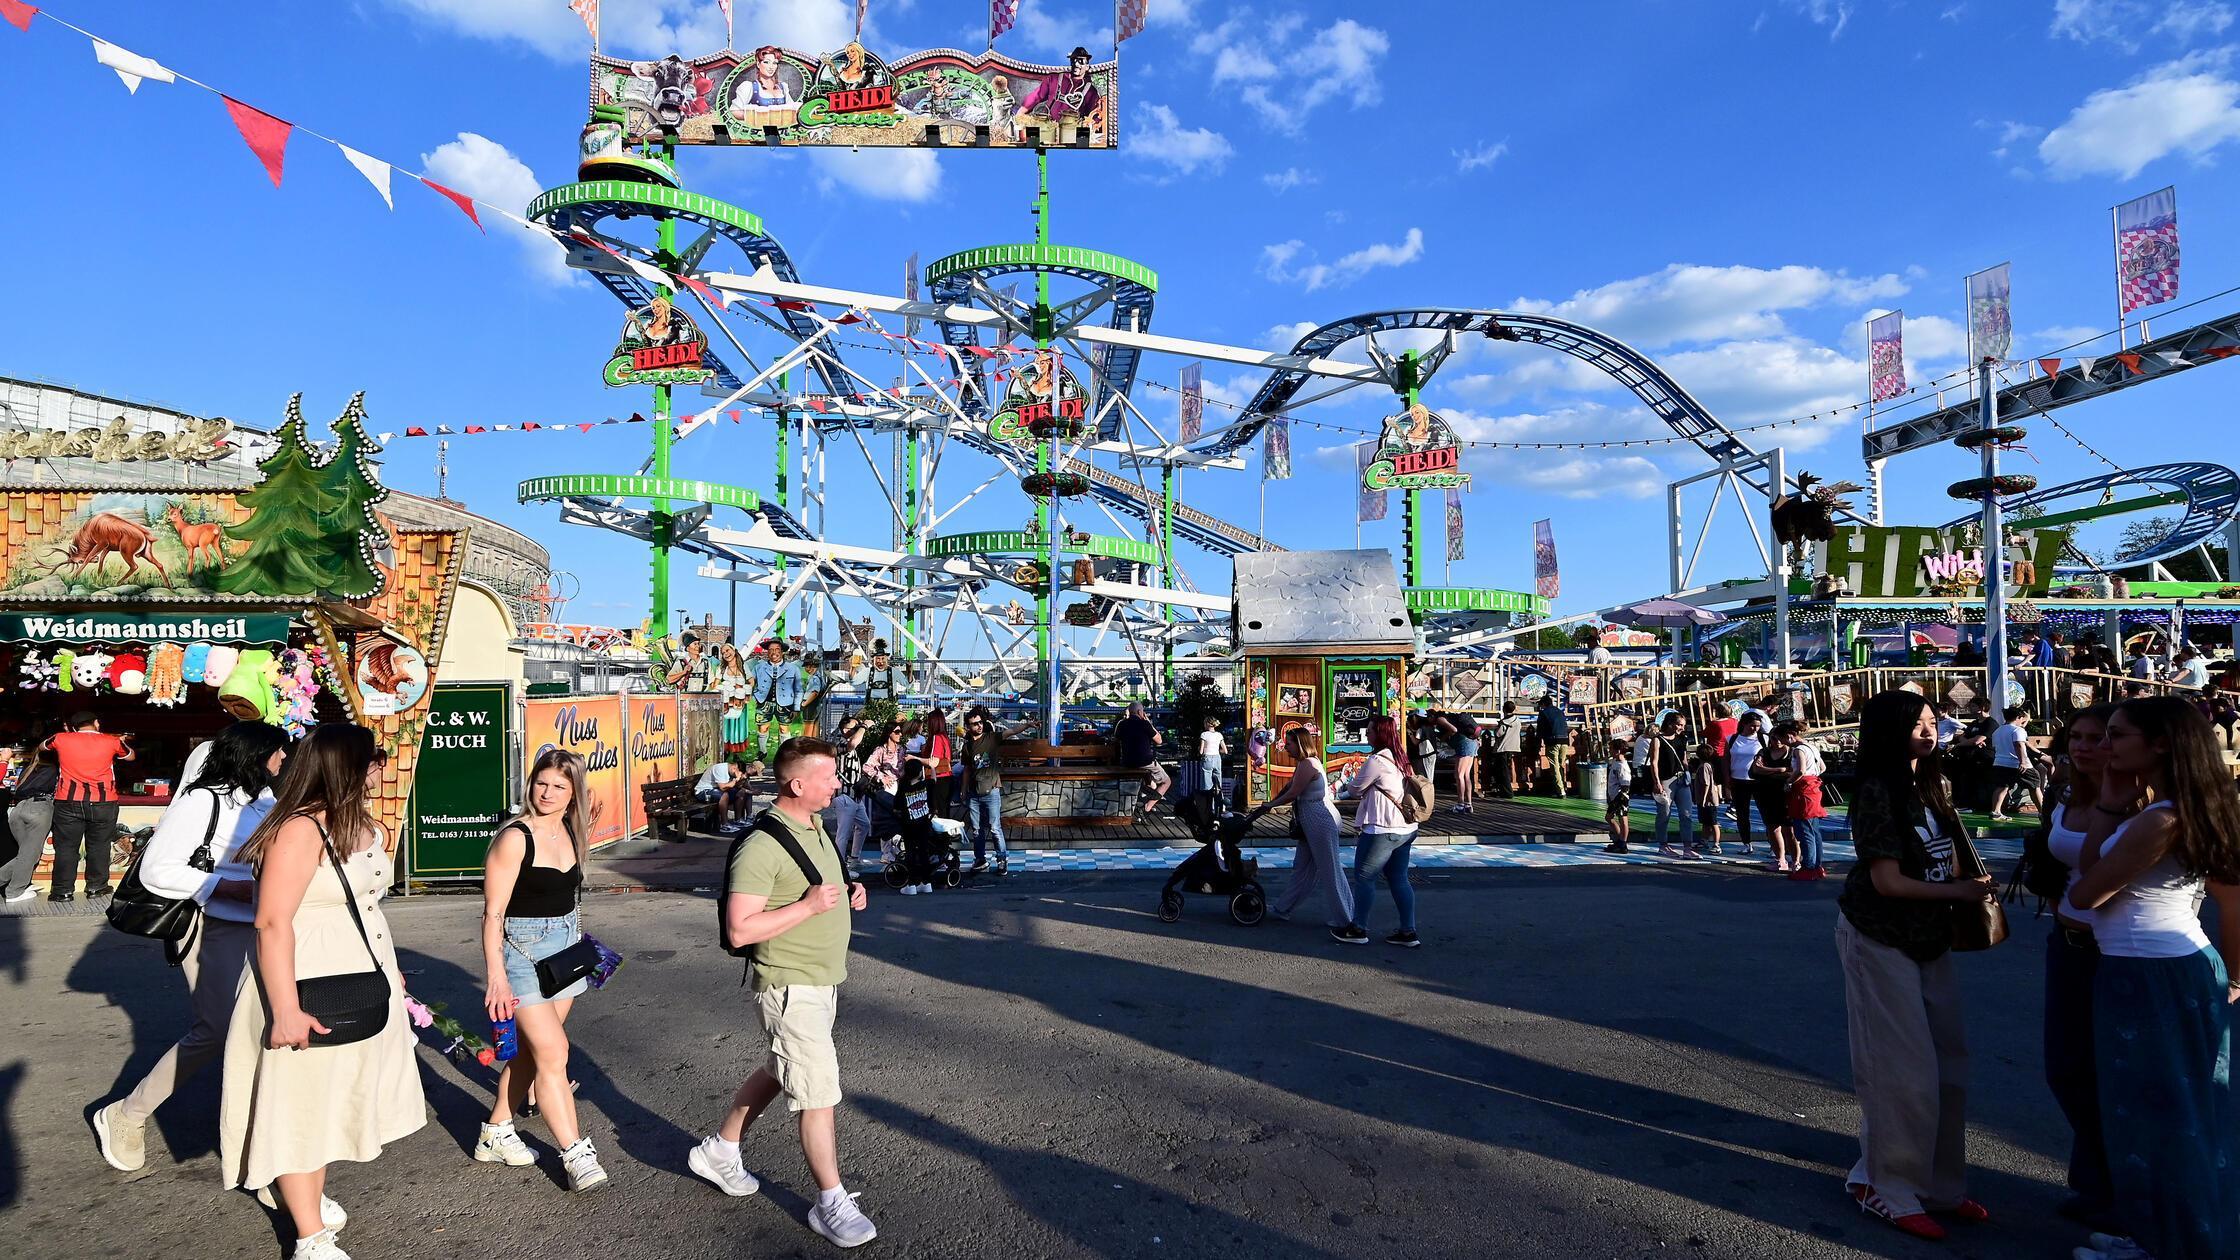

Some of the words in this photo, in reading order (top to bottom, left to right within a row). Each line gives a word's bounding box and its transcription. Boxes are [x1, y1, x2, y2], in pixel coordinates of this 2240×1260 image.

[827, 86, 894, 111] HEIDI
[633, 341, 700, 370] HEIDI
[1018, 399, 1084, 427] HEDI
[1394, 448, 1457, 475] HEIDI
[22, 617, 247, 639] Weidmannsheil
[426, 711, 445, 726] C.
[449, 711, 465, 726] &
[467, 711, 490, 726] W.
[554, 704, 598, 747] Nuss
[642, 702, 666, 736] Nuss
[1342, 709, 1369, 718] OPEN
[431, 734, 487, 749] BUCH
[632, 731, 676, 767] Paradies
[421, 813, 499, 824] Weidmannsheil
[421, 831, 439, 839] TEL.
